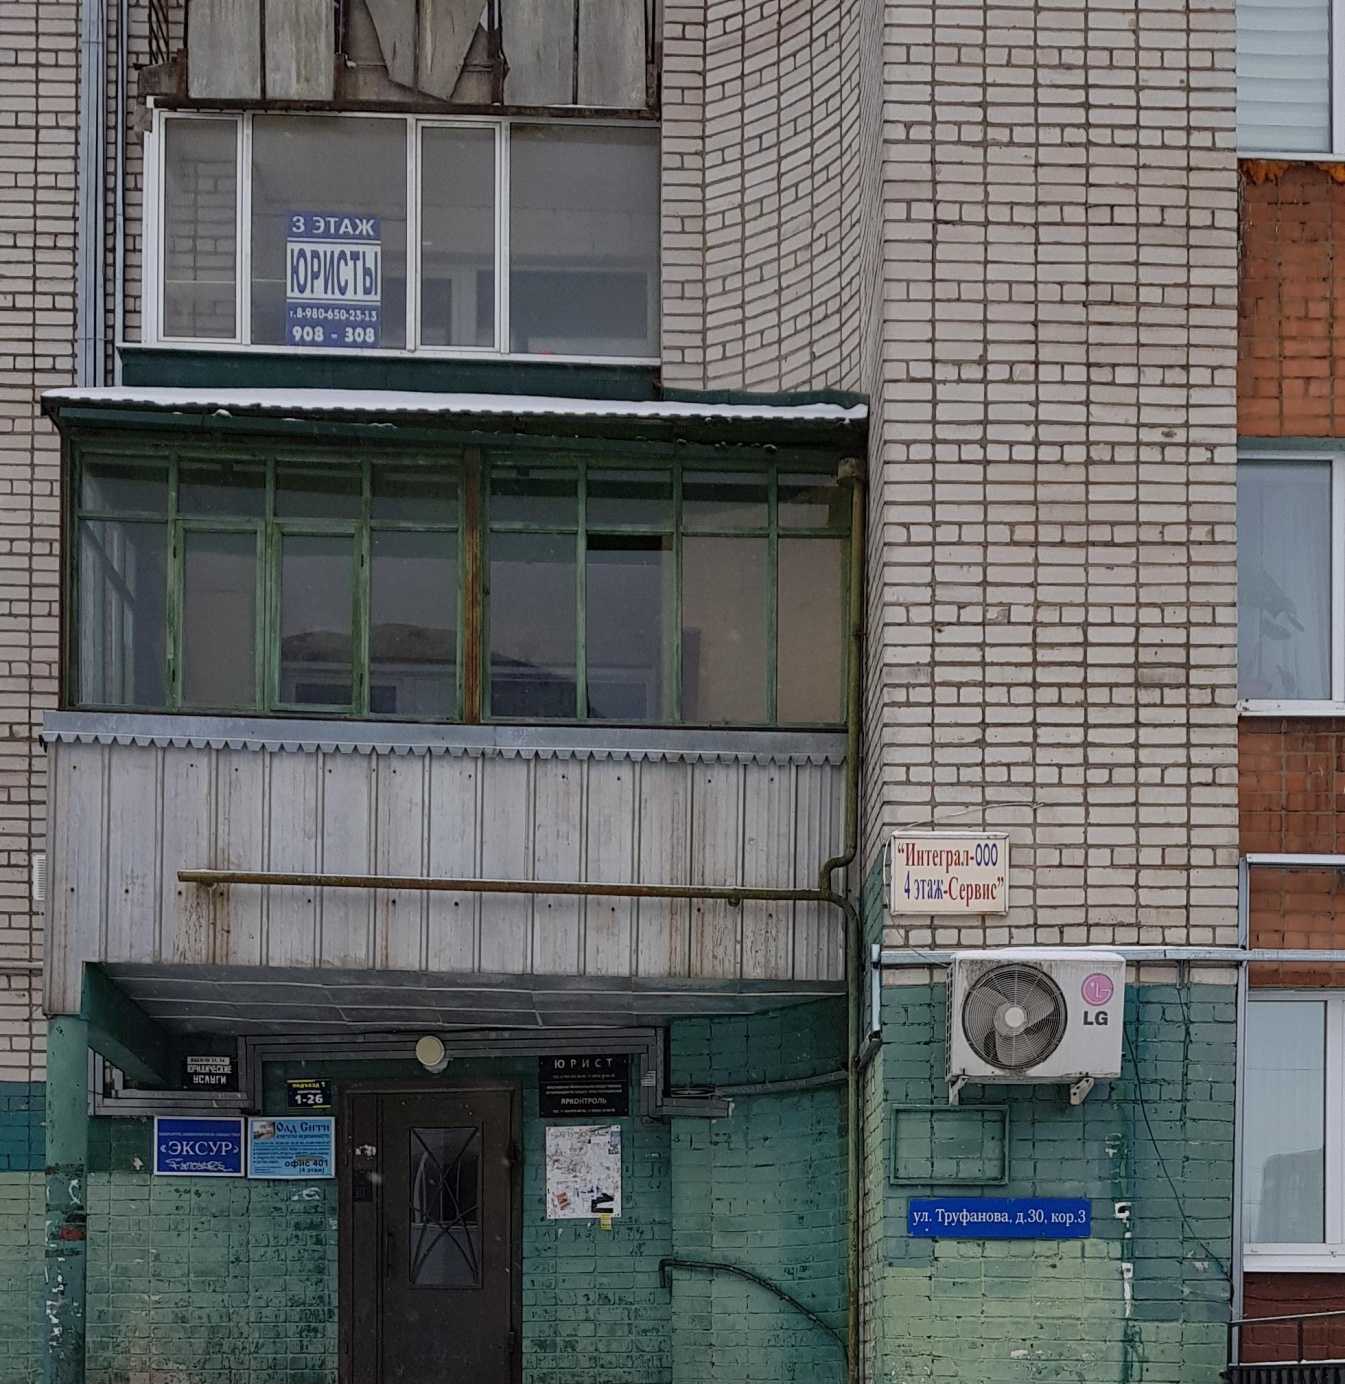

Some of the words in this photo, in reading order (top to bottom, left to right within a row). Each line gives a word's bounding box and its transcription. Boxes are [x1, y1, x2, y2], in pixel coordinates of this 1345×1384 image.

[291, 215, 305, 233] 3
[312, 216, 376, 236] ЭТАЖ
[290, 247, 378, 296] ЮРИСТЫ
[292, 325, 324, 341] 908
[344, 326, 375, 343] 308
[903, 870, 911, 900] 4
[1083, 1010, 1108, 1026] LG
[193, 1074, 226, 1085] УСЛУГИ
[295, 1094, 324, 1105] 1-26
[284, 1159, 310, 1169] офис
[312, 1159, 328, 1168] 401
[912, 1210, 932, 1226] ул.
[935, 1208, 1013, 1226] Труфанова,
[1015, 1209, 1048, 1225] д.30,
[1051, 1209, 1087, 1227] кор.3
